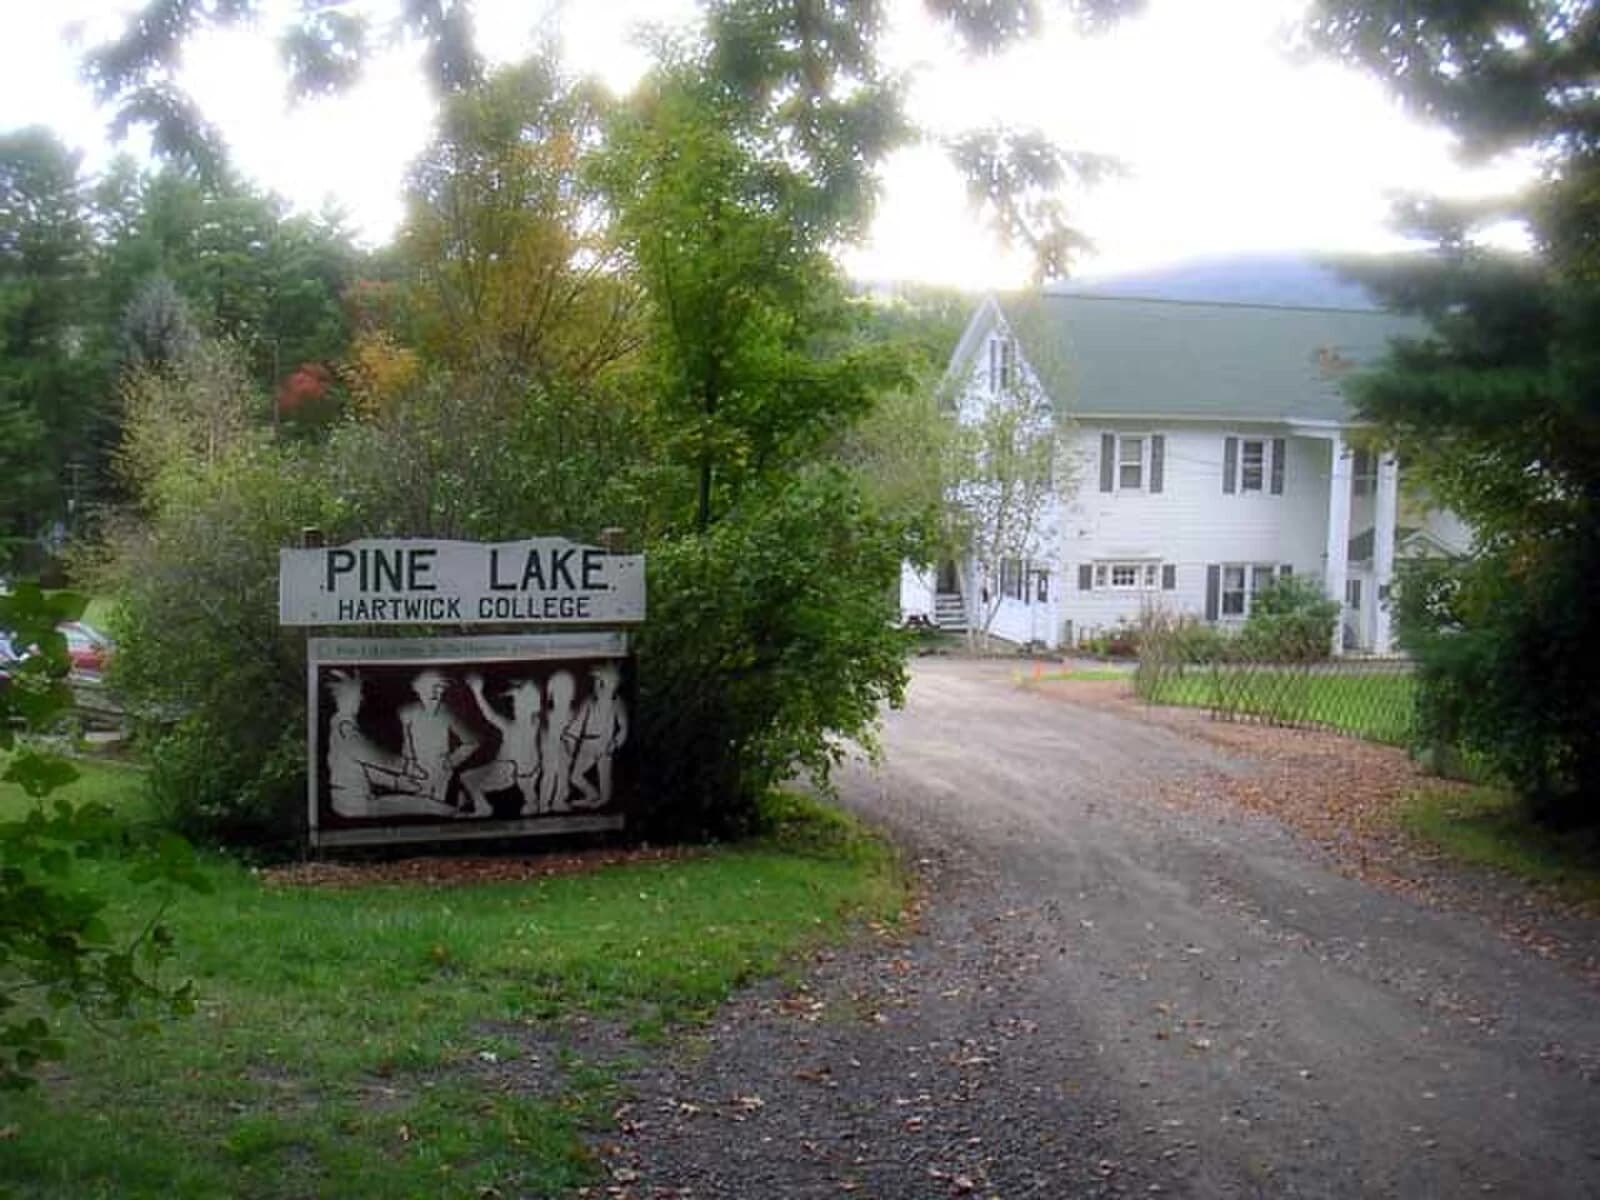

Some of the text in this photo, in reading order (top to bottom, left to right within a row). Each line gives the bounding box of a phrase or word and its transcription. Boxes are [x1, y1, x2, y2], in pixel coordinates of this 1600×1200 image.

[327, 549, 609, 592] PINE LAKE
[338, 597, 591, 620] HARTWICK COLLEGE
